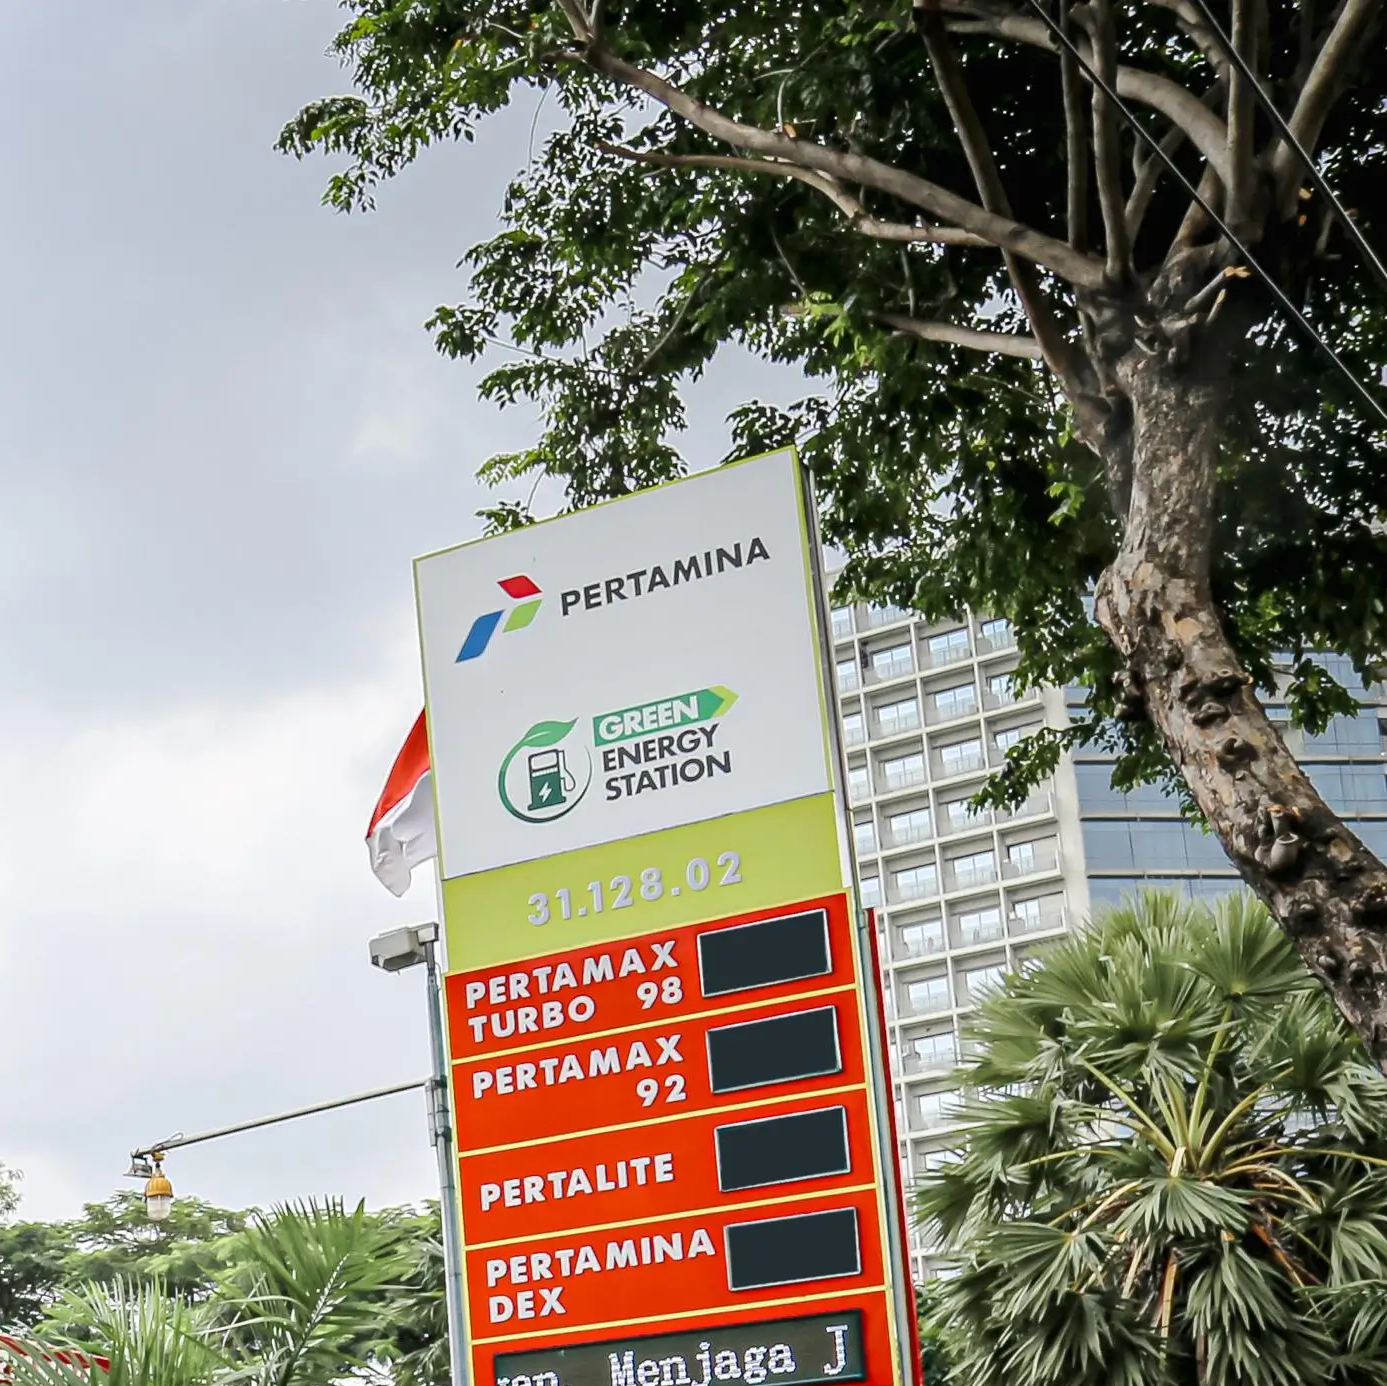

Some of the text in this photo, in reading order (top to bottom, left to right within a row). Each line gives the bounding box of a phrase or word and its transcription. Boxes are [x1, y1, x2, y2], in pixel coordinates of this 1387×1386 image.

[560, 537, 770, 617] PERTAMINA
[597, 695, 700, 740] GREEN
[602, 724, 719, 773] ENERGY
[605, 751, 732, 802] STATION
[528, 850, 743, 926] 31.128.02
[465, 940, 678, 1009] PERTAMAX
[468, 976, 684, 1044] TURBO 98
[472, 1034, 684, 1099] PERTAMAX
[636, 1074, 687, 1108] 92
[480, 1153, 675, 1212] PERTALITE
[486, 1228, 716, 1288] PERTAMINA
[489, 1286, 566, 1324] DEX
